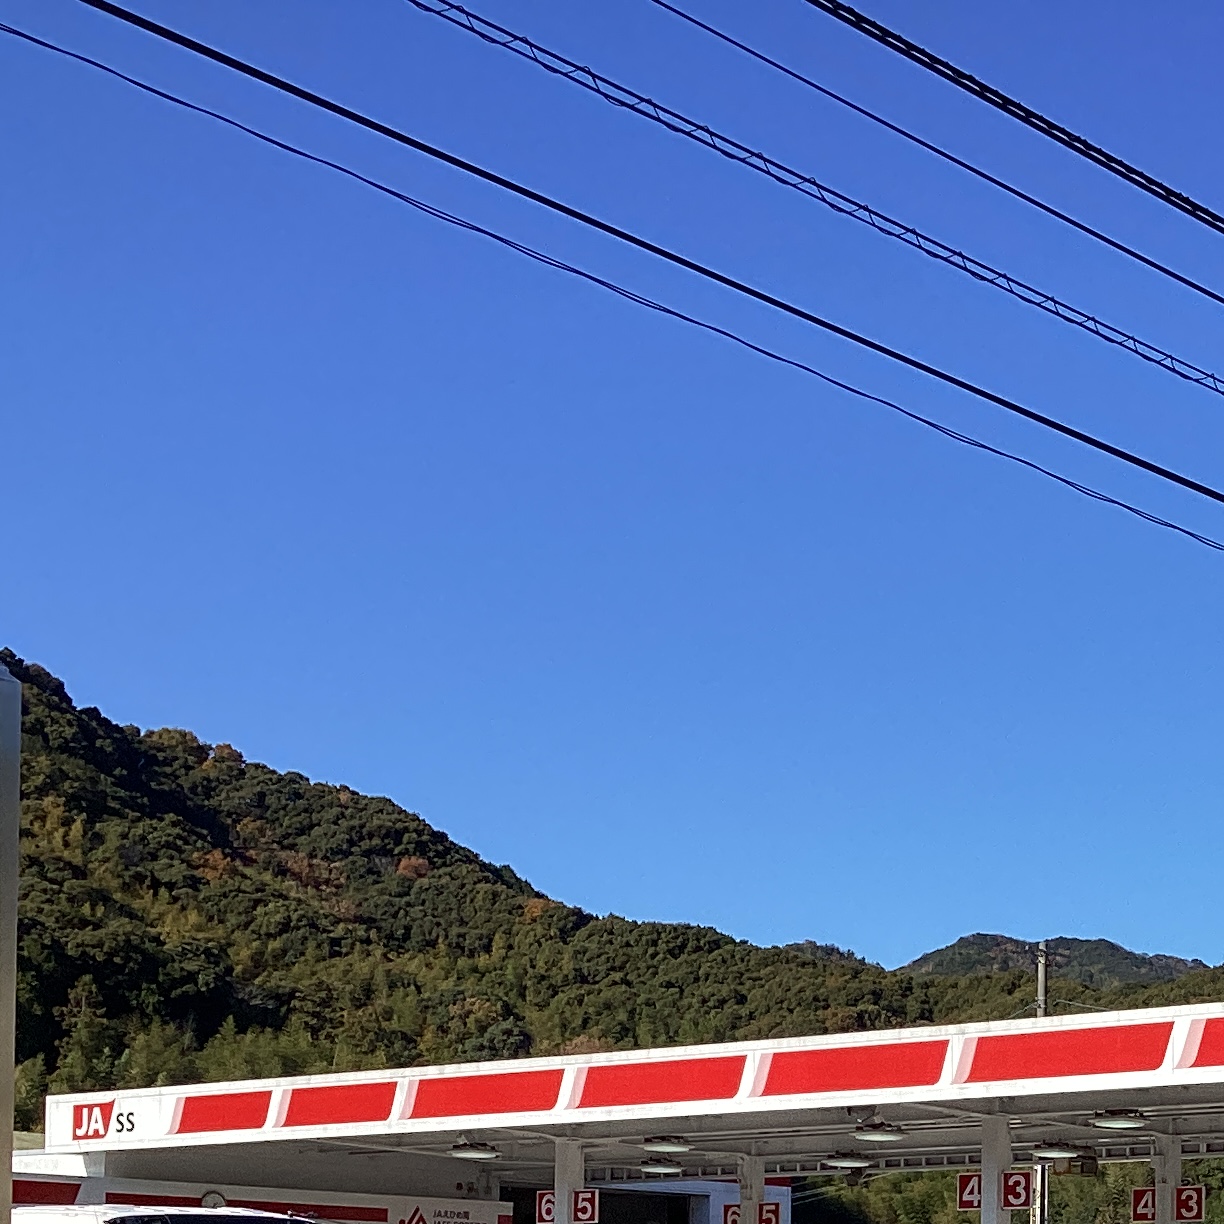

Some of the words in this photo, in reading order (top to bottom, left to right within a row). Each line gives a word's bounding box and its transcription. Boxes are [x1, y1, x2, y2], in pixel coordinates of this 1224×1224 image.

[75, 1106, 106, 1137] JA
[115, 1112, 135, 1133] SS
[962, 1176, 981, 1207] 4
[1007, 1174, 1027, 1206] 3
[1136, 1190, 1155, 1219] 4
[1180, 1189, 1198, 1218] 3
[541, 1193, 556, 1221] 6
[576, 1192, 593, 1220] 5
